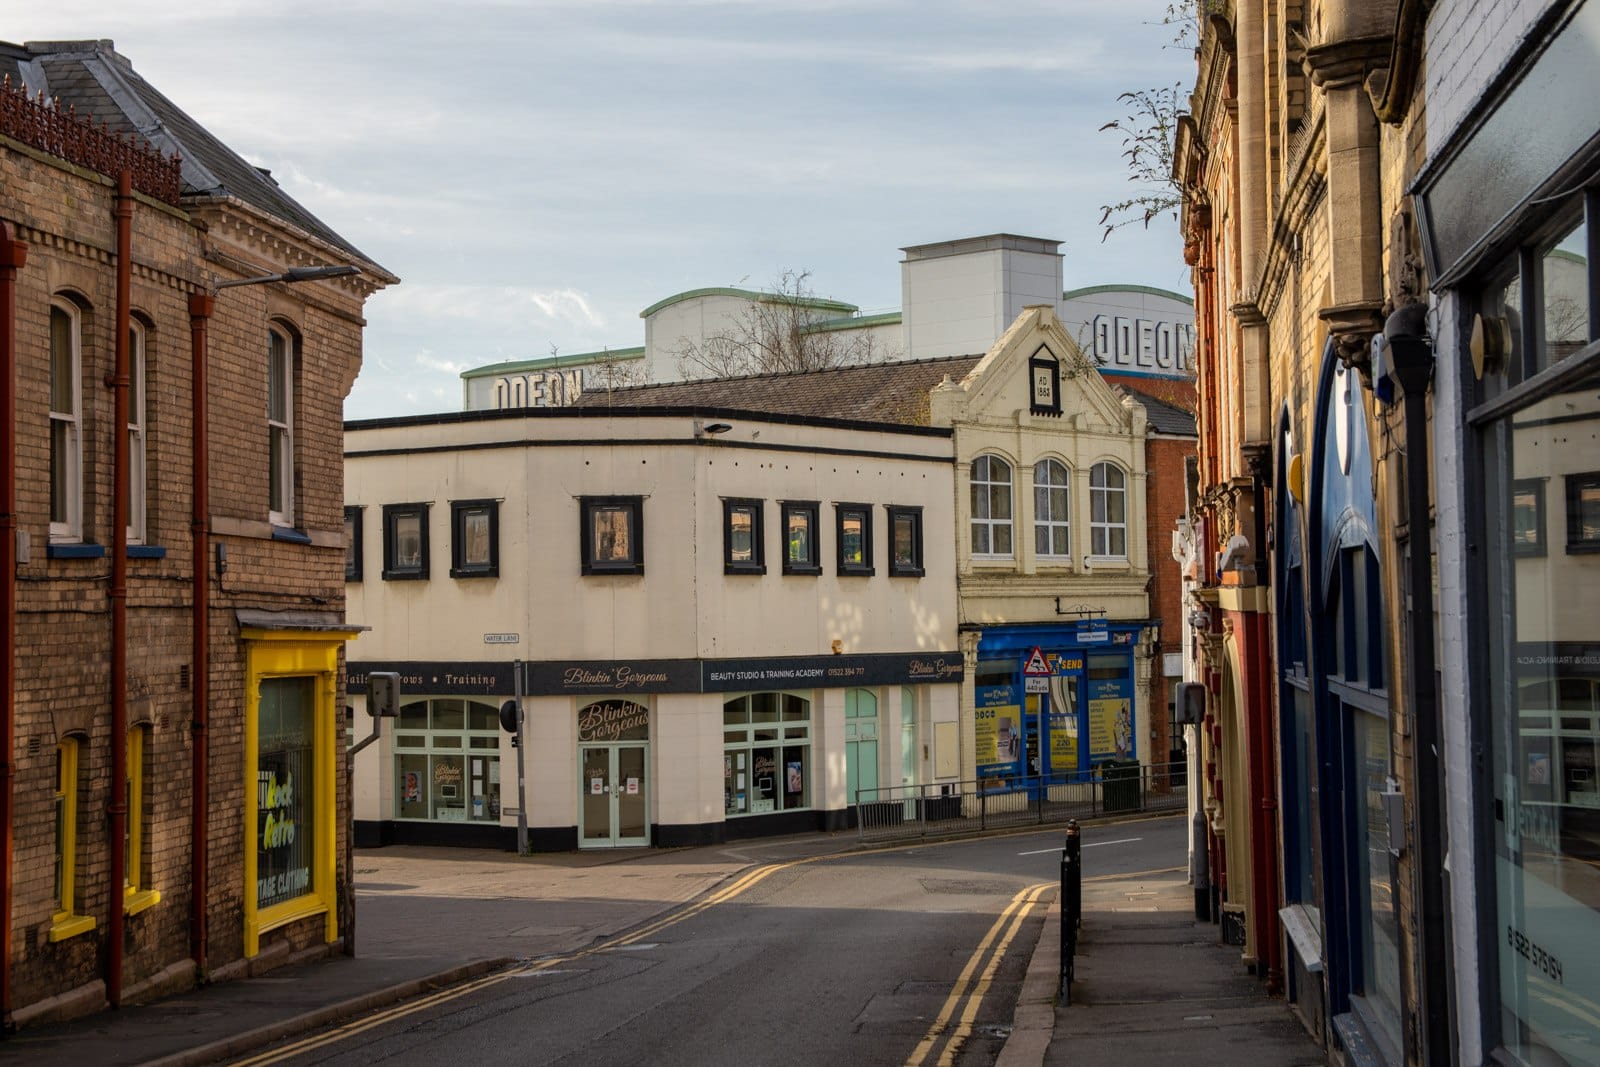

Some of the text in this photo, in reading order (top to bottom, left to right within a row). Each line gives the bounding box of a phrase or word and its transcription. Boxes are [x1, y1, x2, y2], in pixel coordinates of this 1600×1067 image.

[1093, 314, 1196, 370] ODEON
[615, 666, 668, 689] Gorgeous
[710, 672, 736, 681] BEAUTY
[736, 671, 760, 680] STUDIO
[760, 671, 765, 679] &
[766, 670, 795, 678] TRAINING
[795, 669, 824, 677] ACADEMY
[1061, 659, 1083, 670] SEND
[399, 676, 423, 684] rows
[445, 674, 496, 687] Training
[579, 712, 649, 741] Gorgeous
[267, 771, 293, 810] Rock
[264, 809, 295, 850] Retro
[277, 866, 309, 895] CLOTHING
